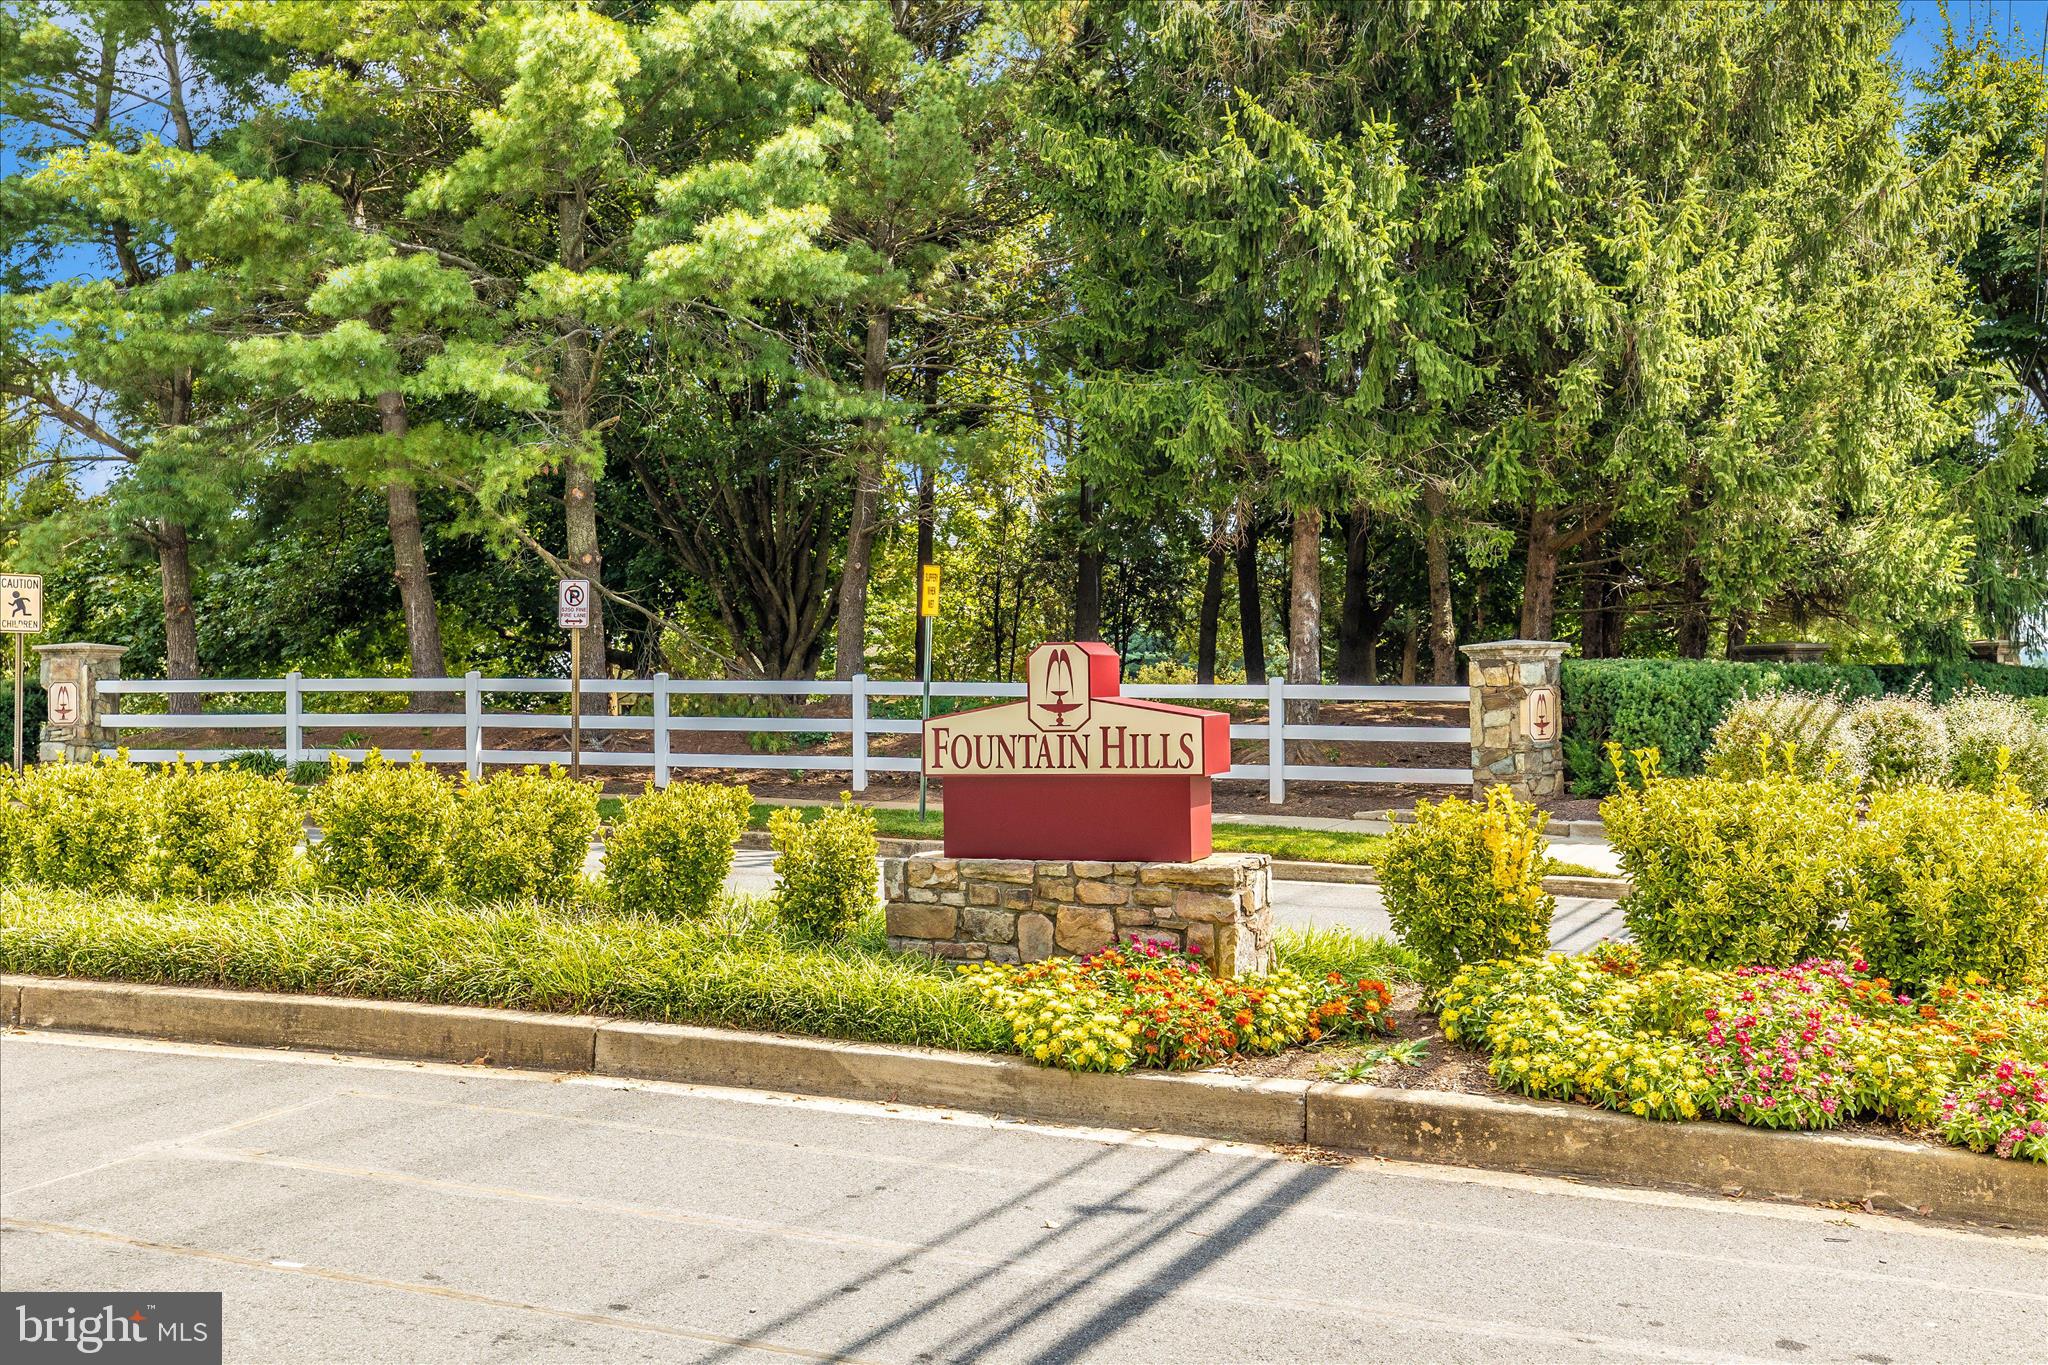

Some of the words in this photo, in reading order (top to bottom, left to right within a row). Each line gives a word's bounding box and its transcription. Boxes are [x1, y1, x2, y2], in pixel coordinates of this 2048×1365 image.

[2, 578, 39, 589] CAUTION
[931, 727, 1090, 769] FOUNTAIN
[1099, 726, 1194, 769] HILLS
